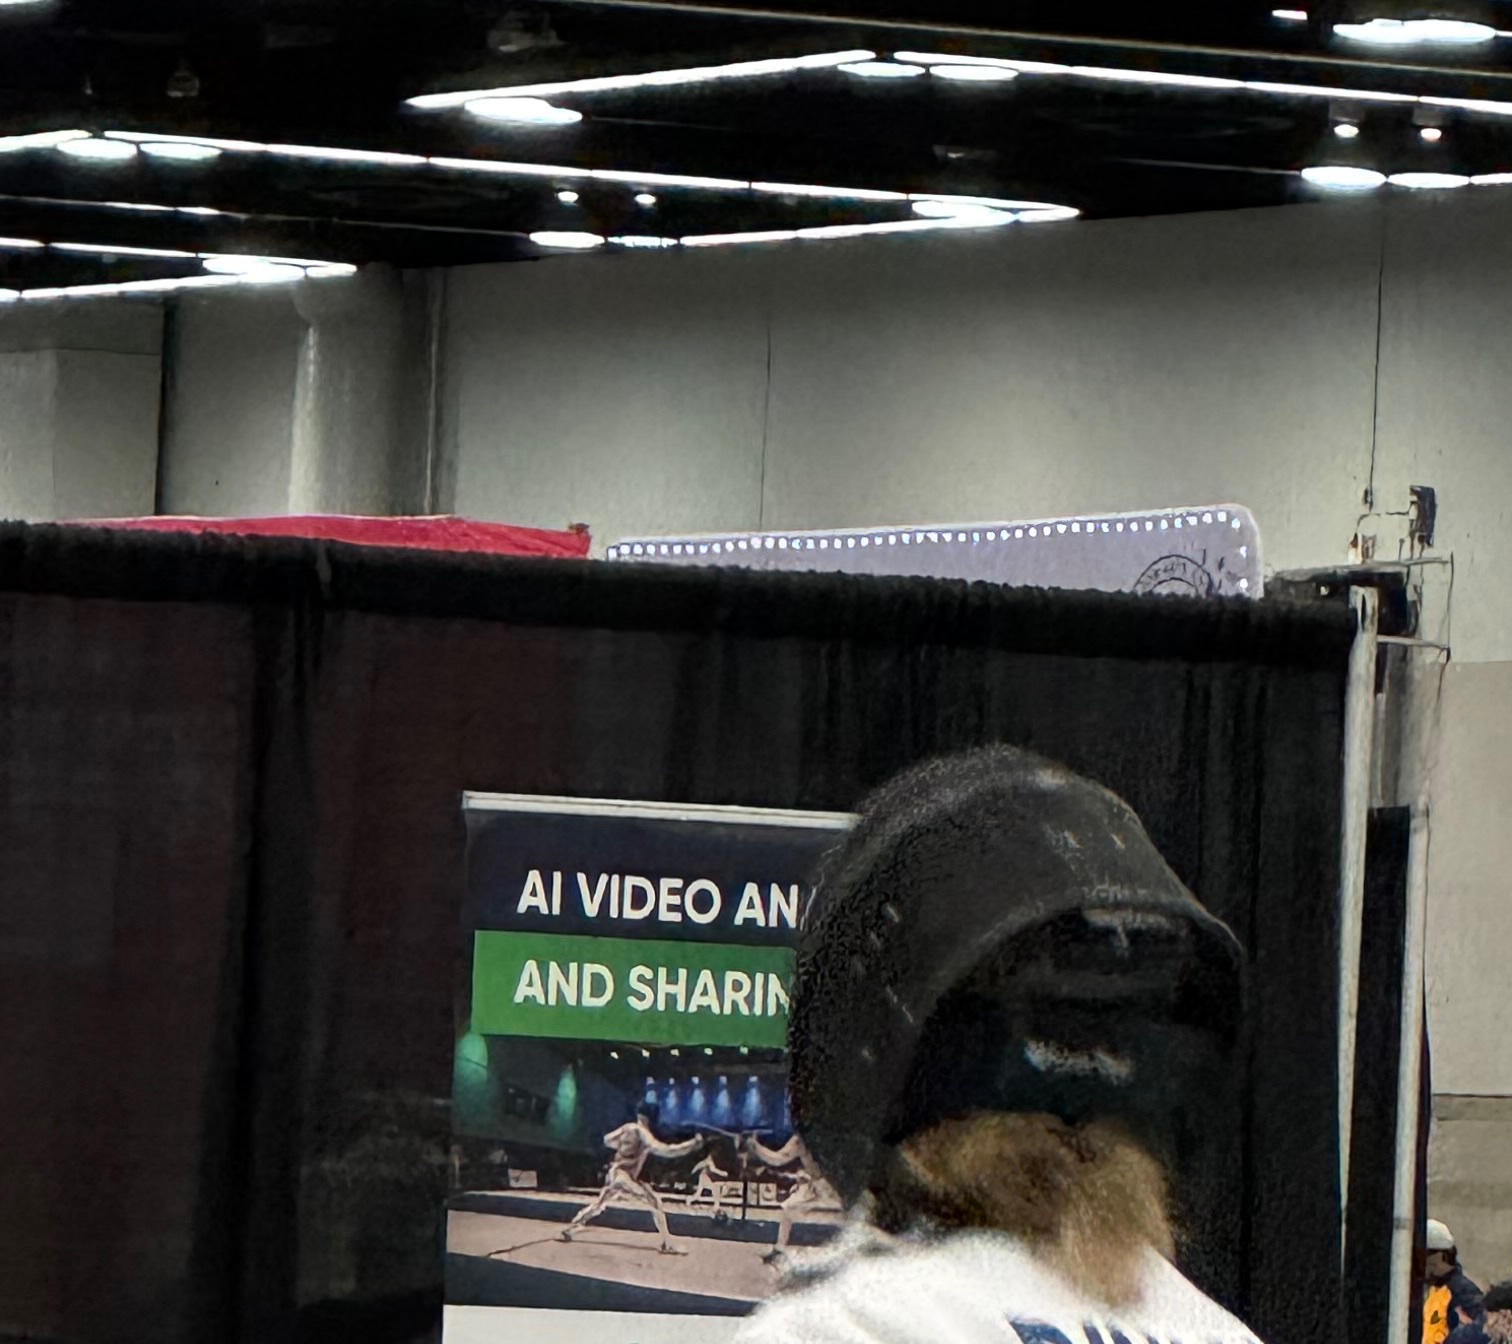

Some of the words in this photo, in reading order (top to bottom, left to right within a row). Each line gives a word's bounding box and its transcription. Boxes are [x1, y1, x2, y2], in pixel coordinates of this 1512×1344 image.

[516, 869, 562, 916] AI
[576, 872, 721, 925] VIDEO
[733, 882, 816, 931] AN
[513, 960, 615, 1008] AND
